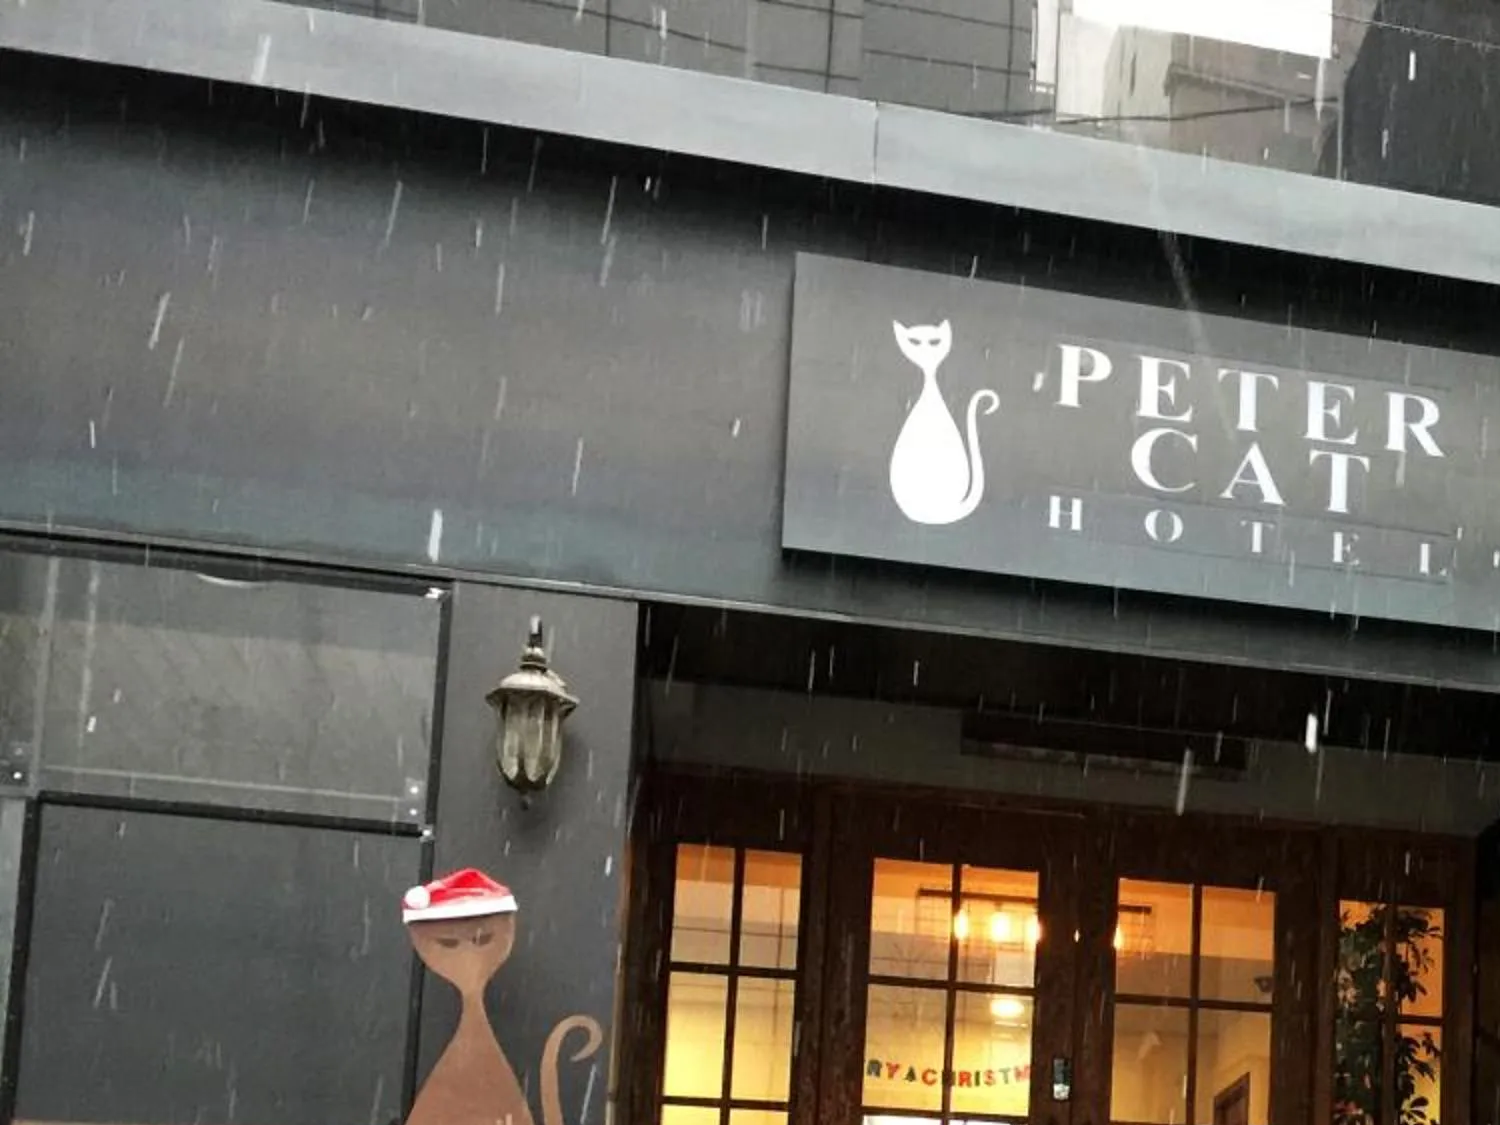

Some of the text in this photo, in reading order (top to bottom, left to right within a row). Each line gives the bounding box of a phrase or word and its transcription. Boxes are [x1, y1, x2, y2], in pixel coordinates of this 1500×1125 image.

[1054, 343, 1445, 457] PETER
[1131, 427, 1371, 513] CAT
[1048, 495, 1449, 577] HOTEL
